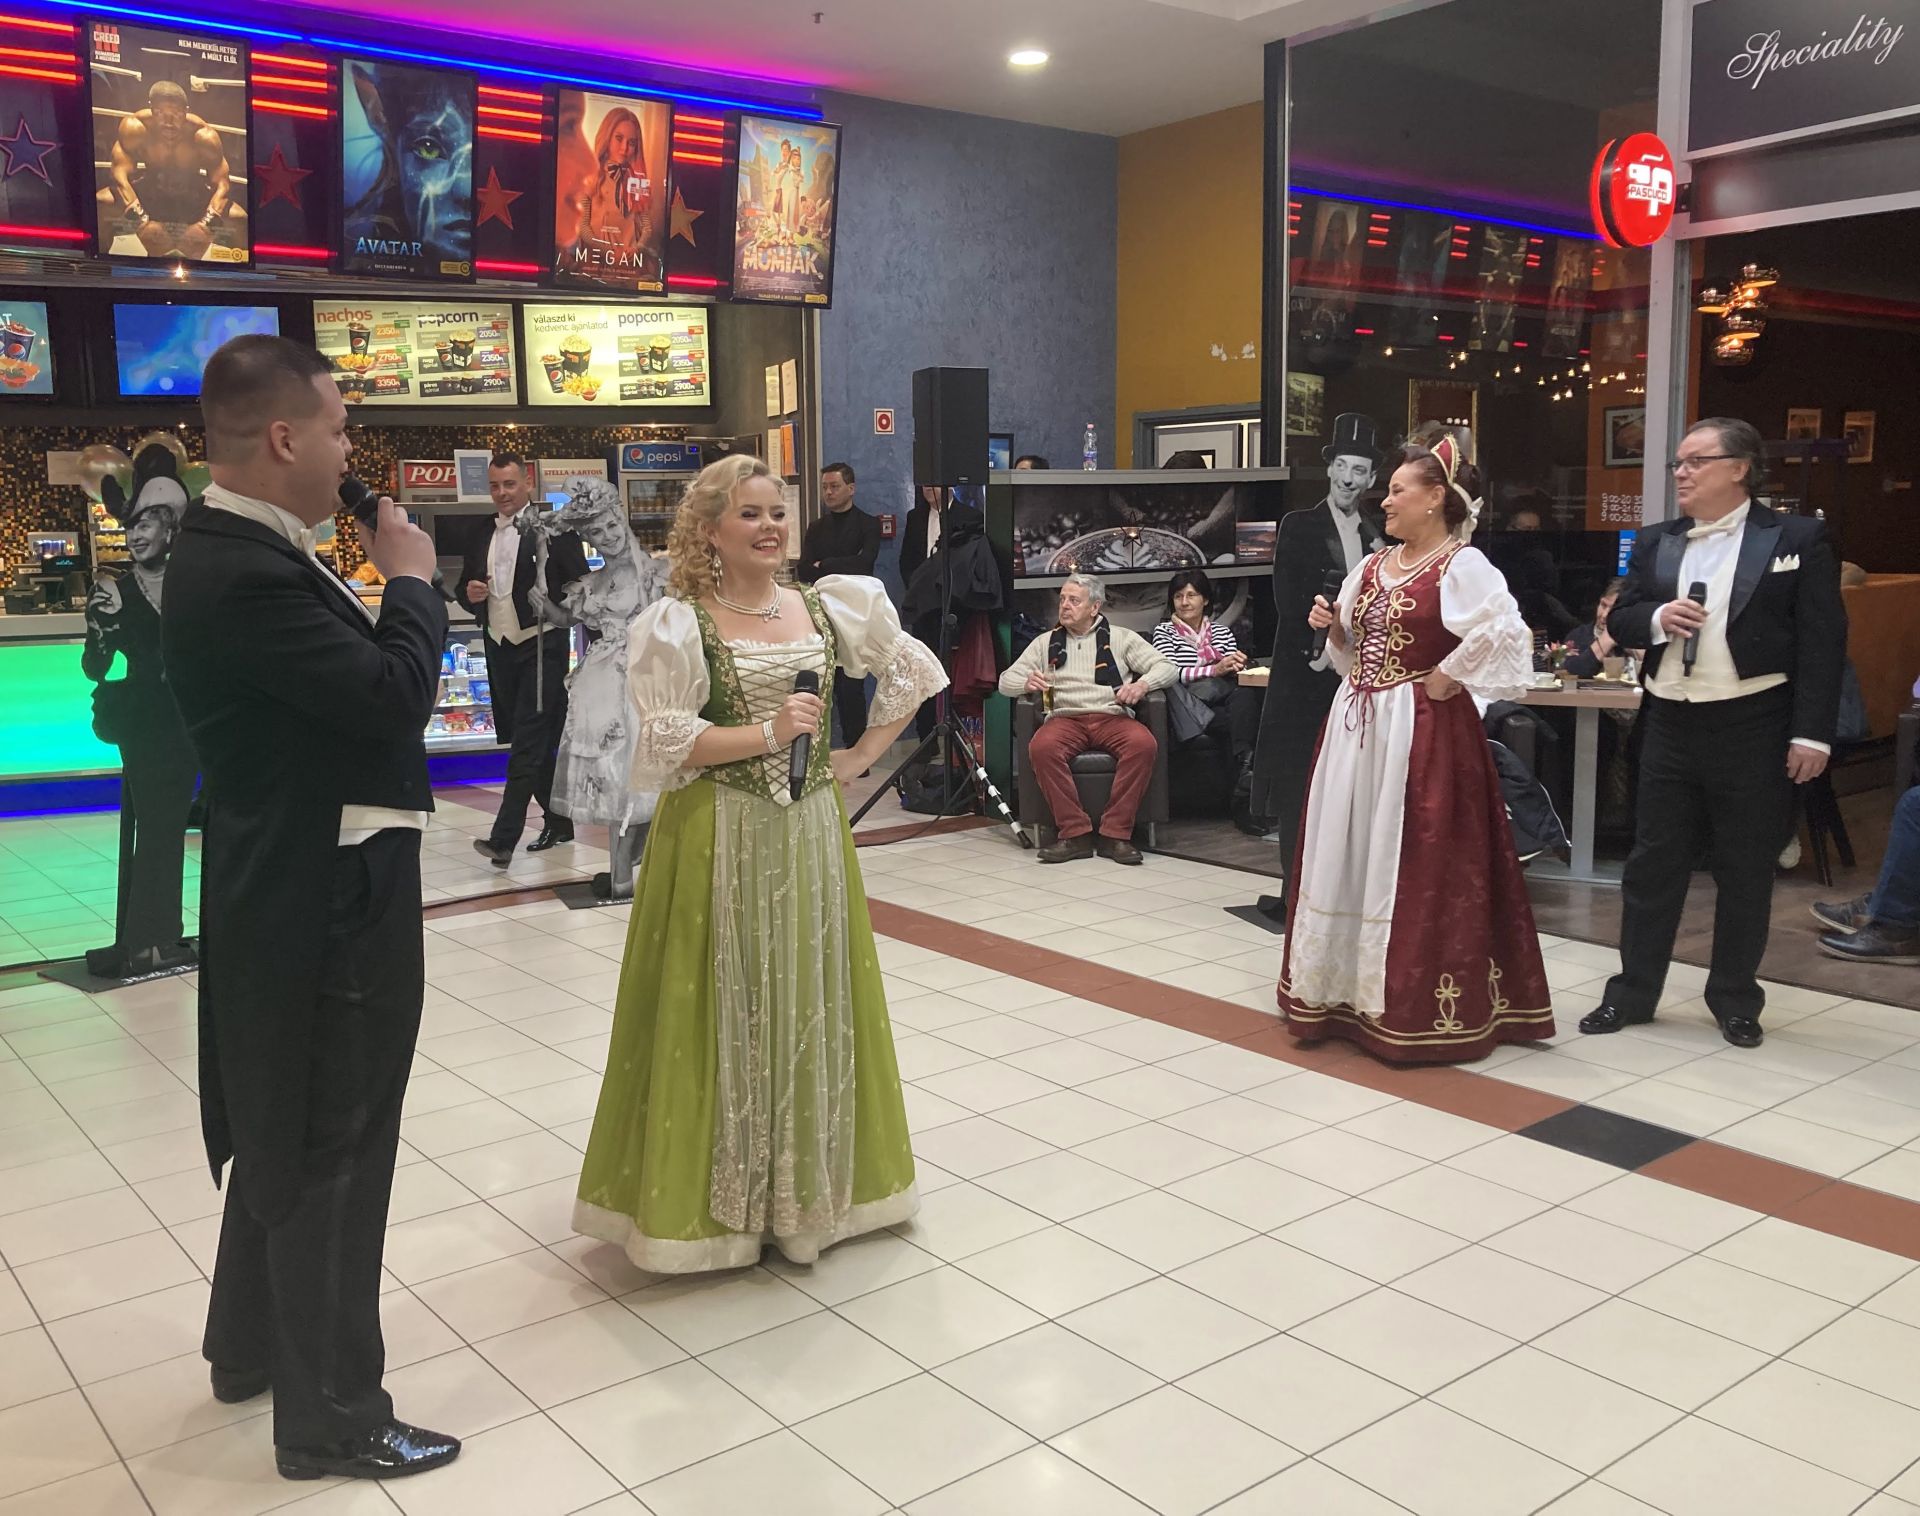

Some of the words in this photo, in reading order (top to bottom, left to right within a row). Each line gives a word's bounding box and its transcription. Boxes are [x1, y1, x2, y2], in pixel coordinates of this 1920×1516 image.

[94, 31, 120, 44] CREED
[179, 39, 192, 49] NEM
[1726, 13, 1905, 90] Speciality
[355, 236, 424, 257] AVATAR
[575, 247, 643, 268] MEGAN
[316, 307, 373, 323] nachos
[417, 311, 479, 328] popcorn
[533, 313, 566, 324] válaszd
[567, 313, 576, 322] ki
[618, 311, 674, 328] popcorn
[534, 322, 570, 333] kedvenc
[647, 451, 682, 464] pepsi
